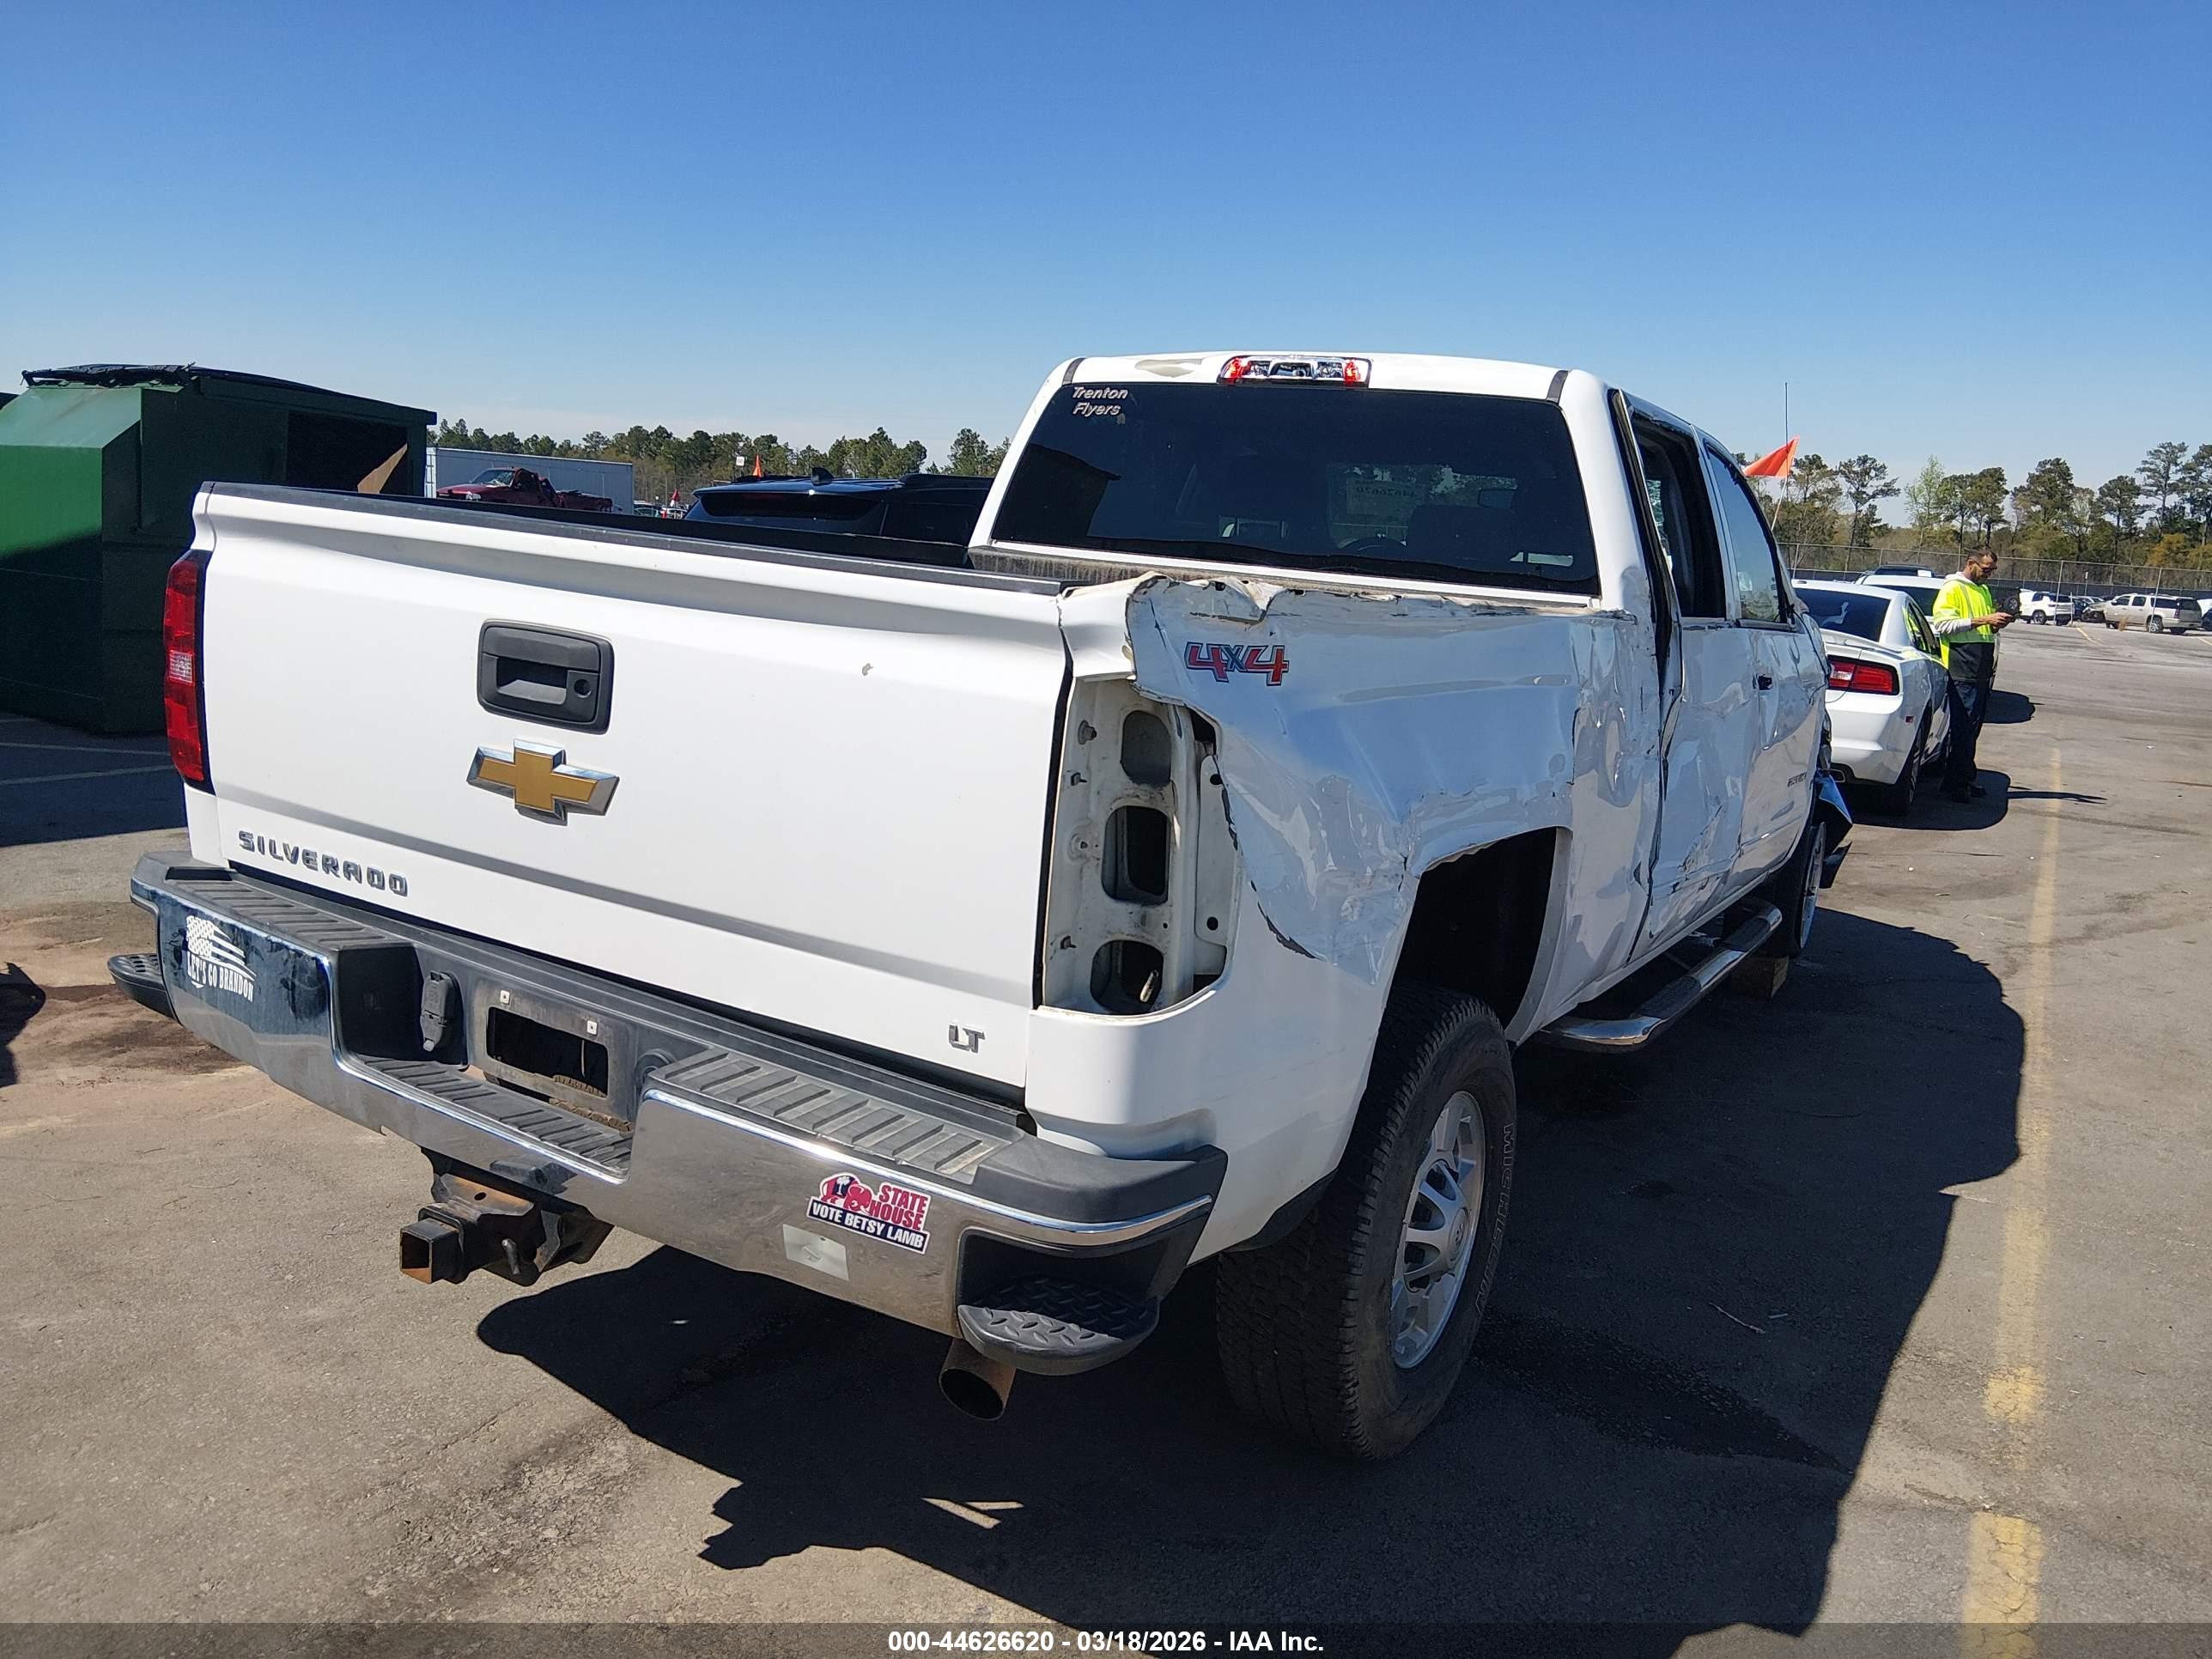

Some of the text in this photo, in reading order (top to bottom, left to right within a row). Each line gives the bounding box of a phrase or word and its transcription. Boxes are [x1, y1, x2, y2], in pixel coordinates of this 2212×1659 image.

[1072, 386, 1128, 399] Trenton
[1073, 402, 1121, 417] Flyers
[239, 830, 408, 896] SILVERADO
[187, 951, 254, 1003] LET'S GO BRANDON
[949, 1024, 985, 1053] LT
[878, 1184, 928, 1214] STATE
[812, 1202, 925, 1249] VOTE BETSY LAMB
[869, 1199, 924, 1231] HOUSE
